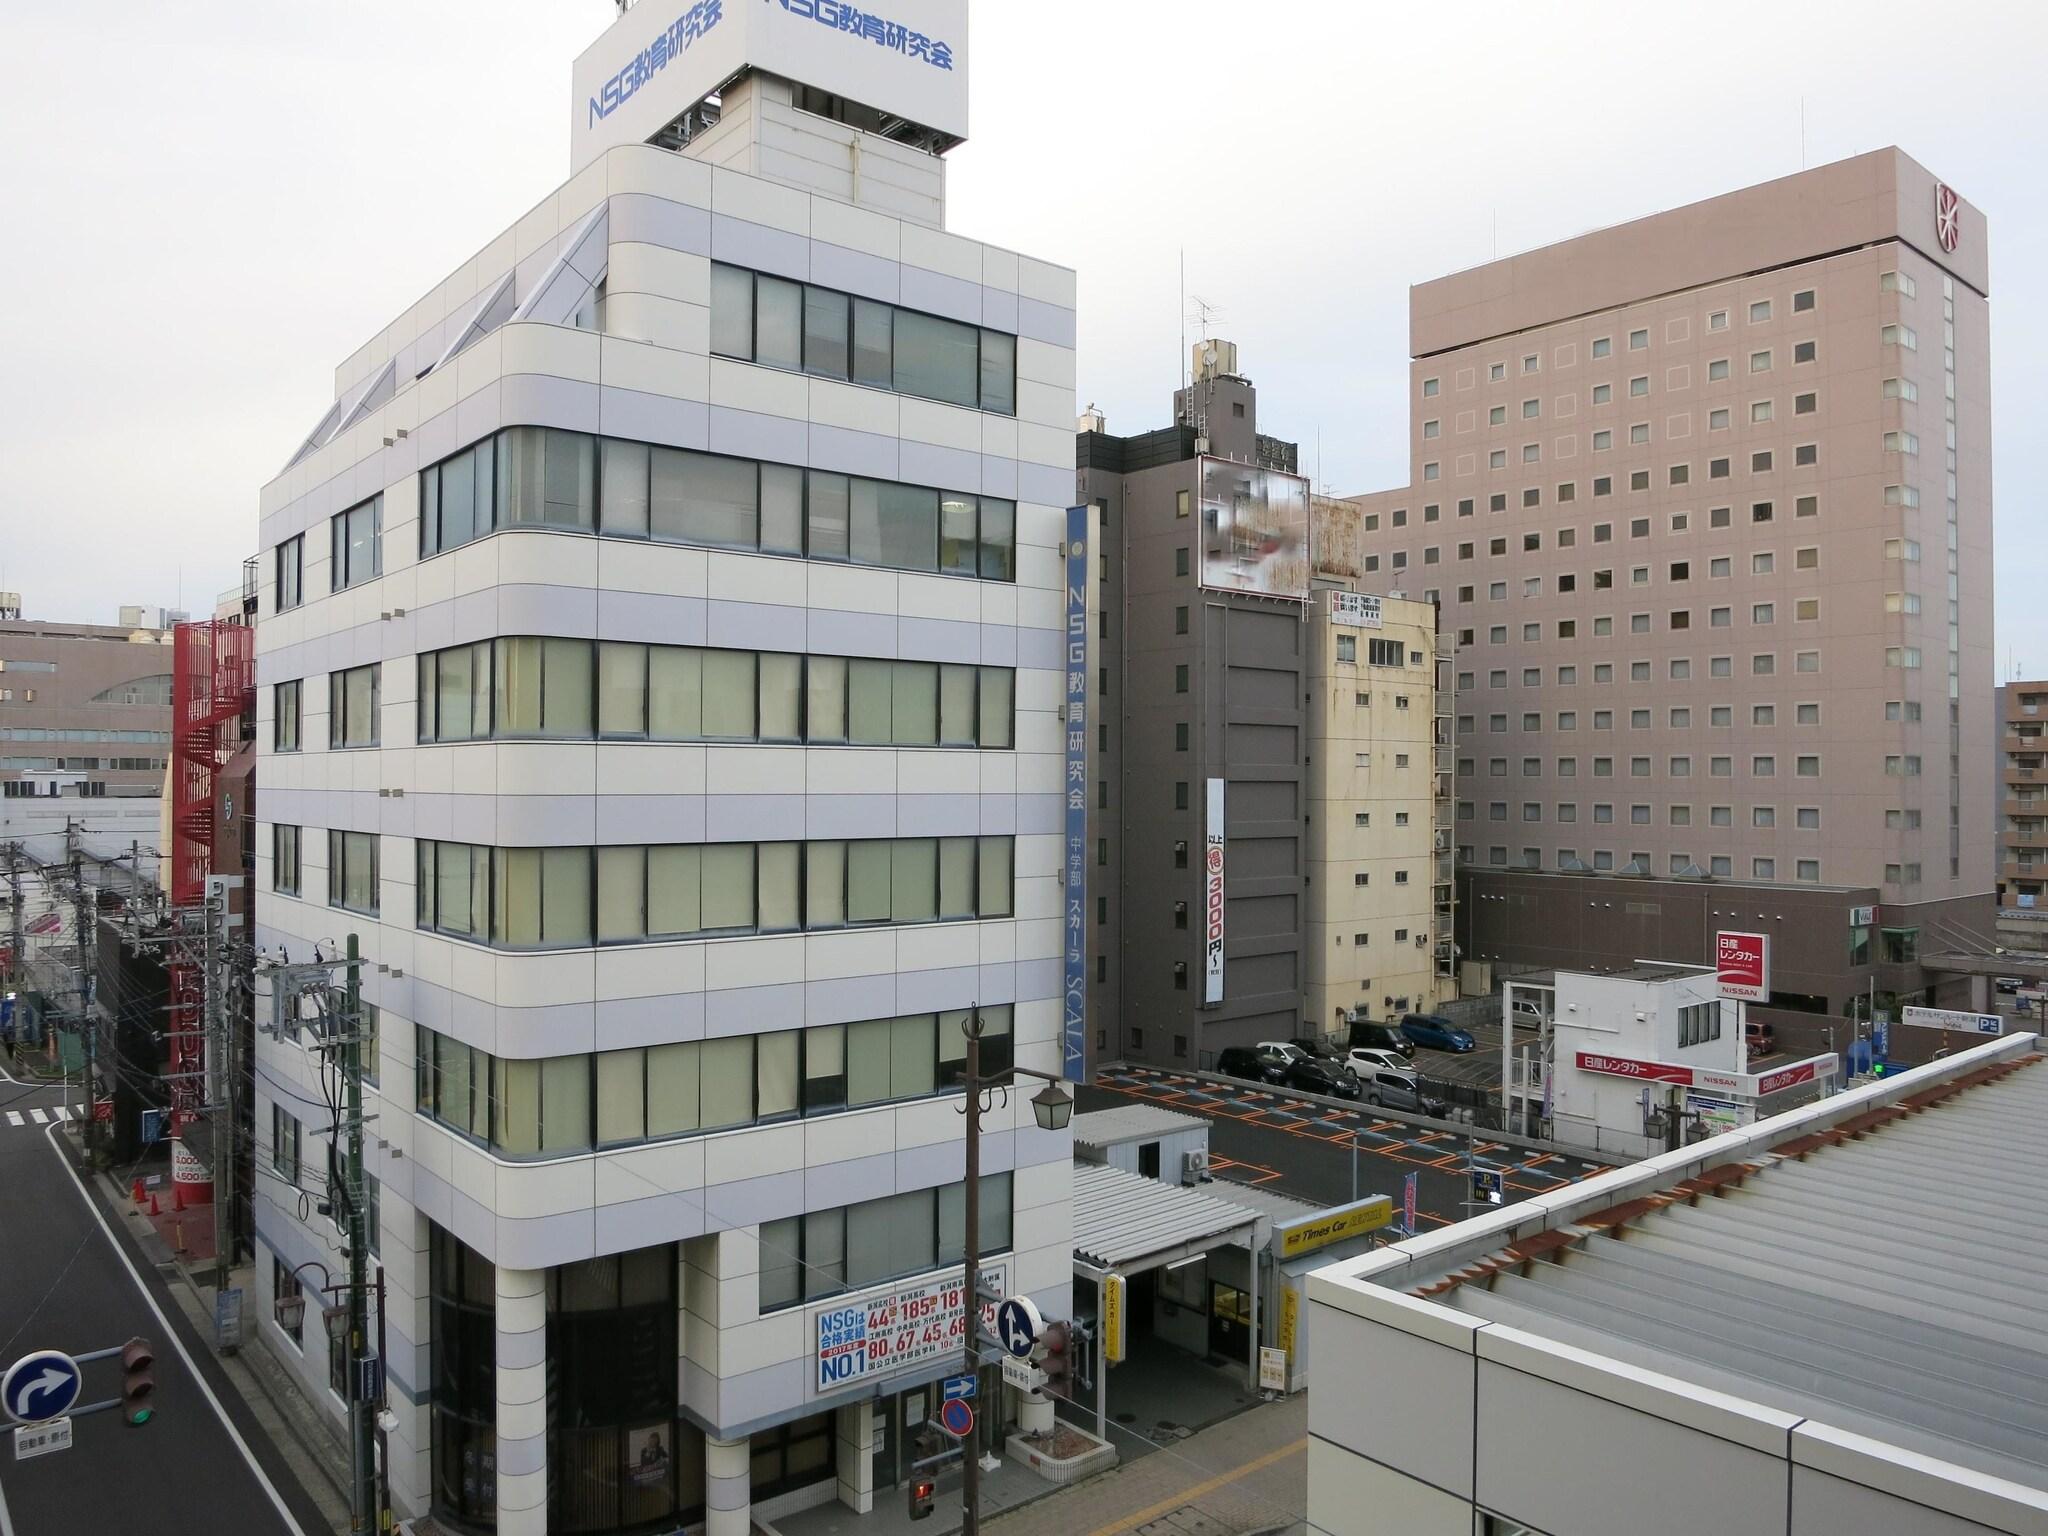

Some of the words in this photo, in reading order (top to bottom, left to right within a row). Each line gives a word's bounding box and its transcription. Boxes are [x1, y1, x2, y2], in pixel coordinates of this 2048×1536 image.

[589, 0, 723, 129] NSG教育研究会
[1069, 585, 1085, 810] NSG教育研究会
[1069, 899, 1081, 963] スカーラ
[1719, 938, 1738, 949] 日産
[1719, 950, 1760, 961] レンタカー
[1722, 986, 1758, 996] NISSAN
[1066, 975, 1083, 1060] SCALA
[1980, 1018, 1990, 1030] P
[1584, 1056, 1648, 1074] 日産レンタカー
[1703, 1076, 1737, 1087] NISSAN
[1302, 1225, 1331, 1242] Times
[1332, 1220, 1347, 1232] Car
[821, 1308, 865, 1334] NSGは
[821, 1325, 866, 1349] 合格実績
[821, 1348, 865, 1385] NO.1
